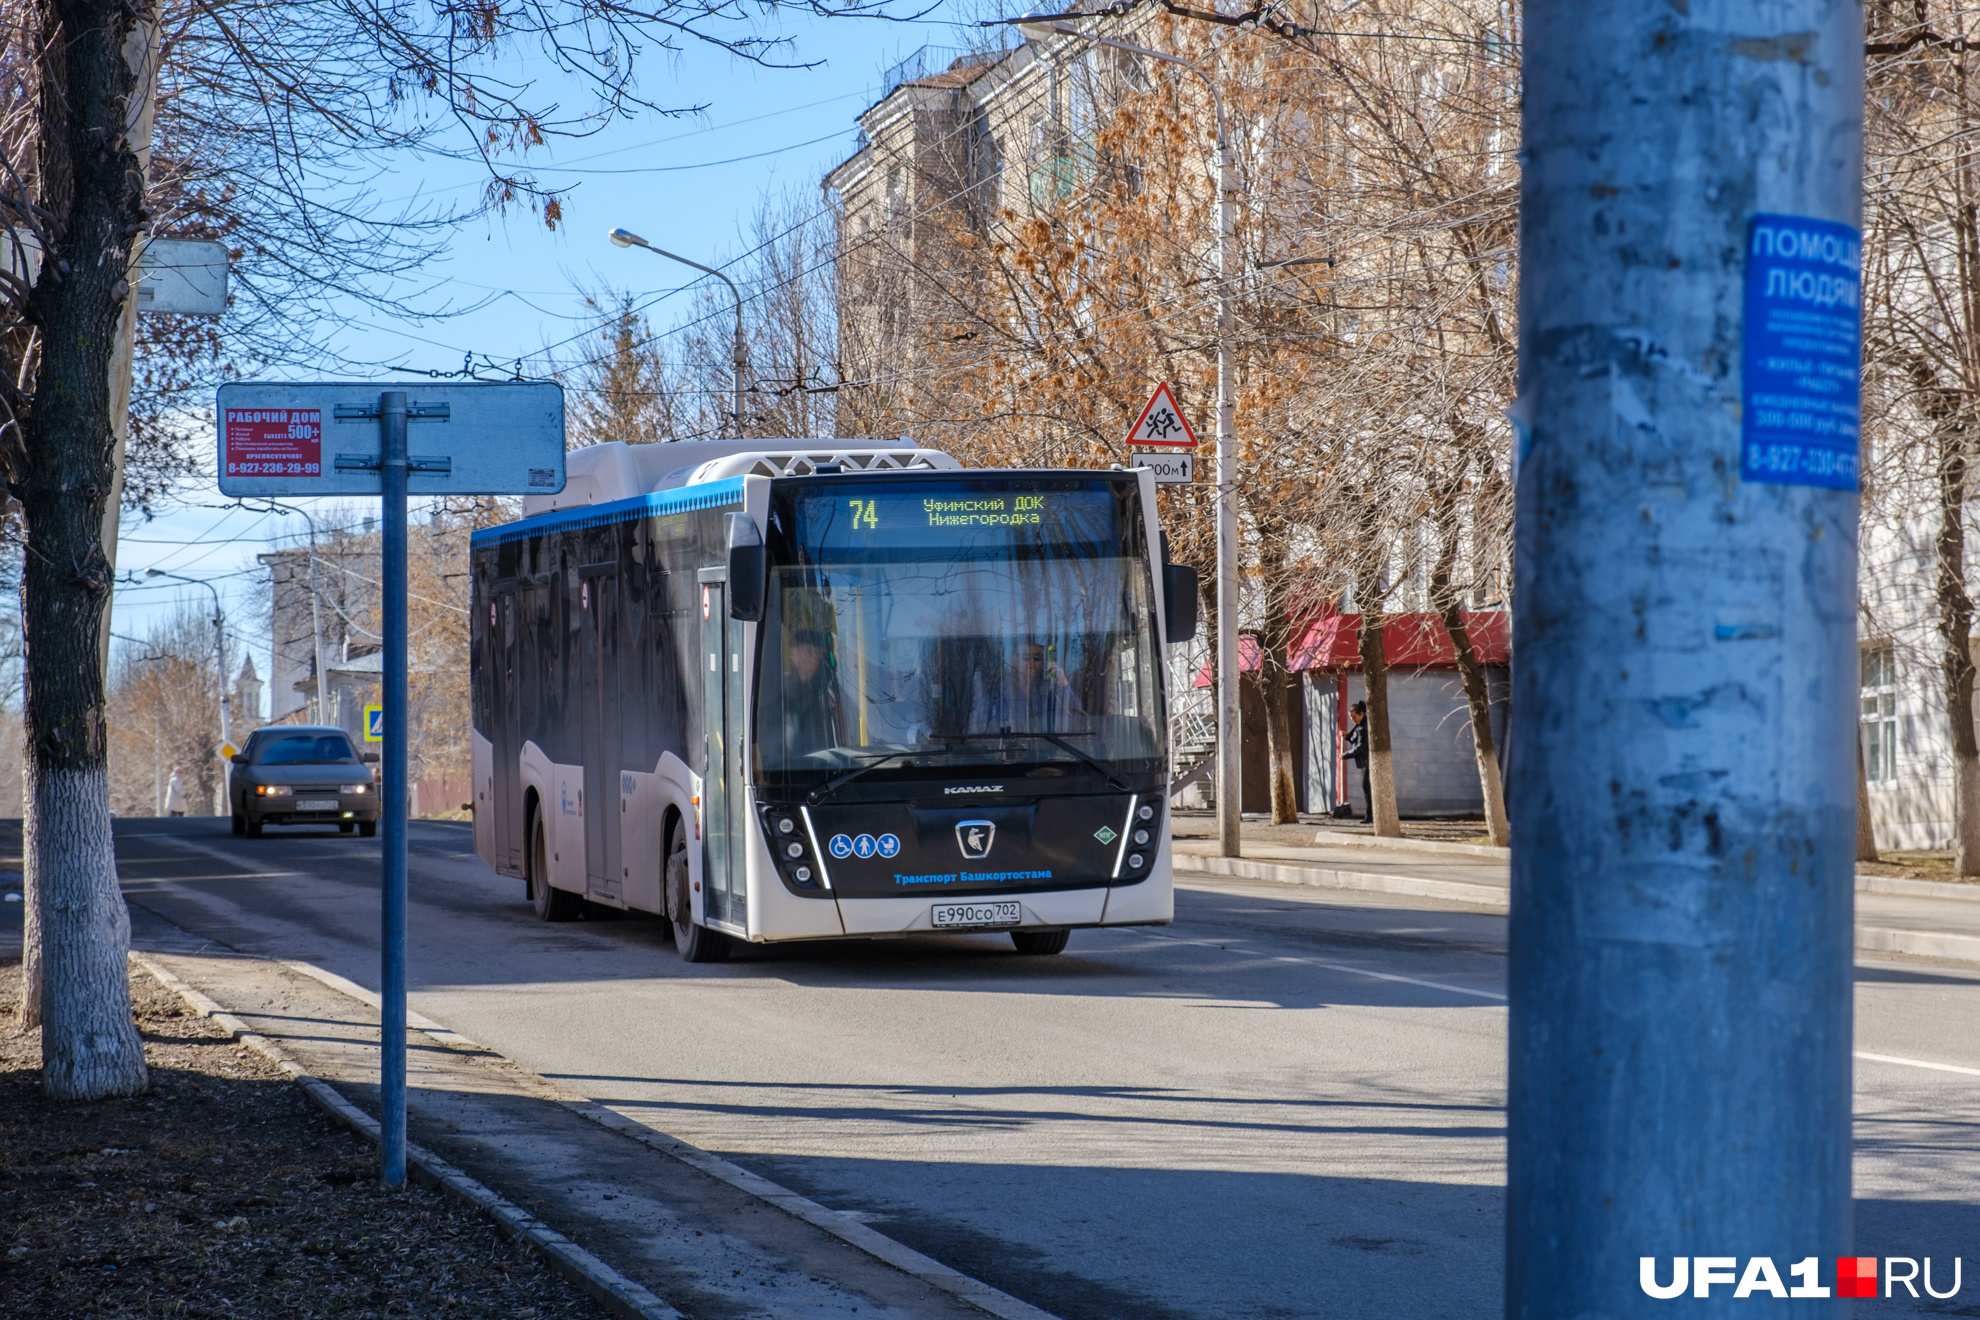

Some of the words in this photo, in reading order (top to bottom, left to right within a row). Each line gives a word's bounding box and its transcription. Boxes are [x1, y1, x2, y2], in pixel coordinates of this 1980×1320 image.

[228, 410, 288, 423] РАБОЧИЙ
[290, 411, 320, 424] ДОМ
[288, 424, 320, 439] 500+
[228, 462, 319, 473] 8-927-236-29-99
[923, 499, 1004, 512] Уфимский
[1014, 496, 1044, 511] ДОК
[849, 501, 878, 529] 74
[929, 513, 1040, 526] Нижегородка
[944, 785, 1004, 794] KAMAZ
[894, 874, 957, 886] Транспорт
[960, 870, 1052, 882] Башкортостана
[995, 904, 1016, 916] 702
